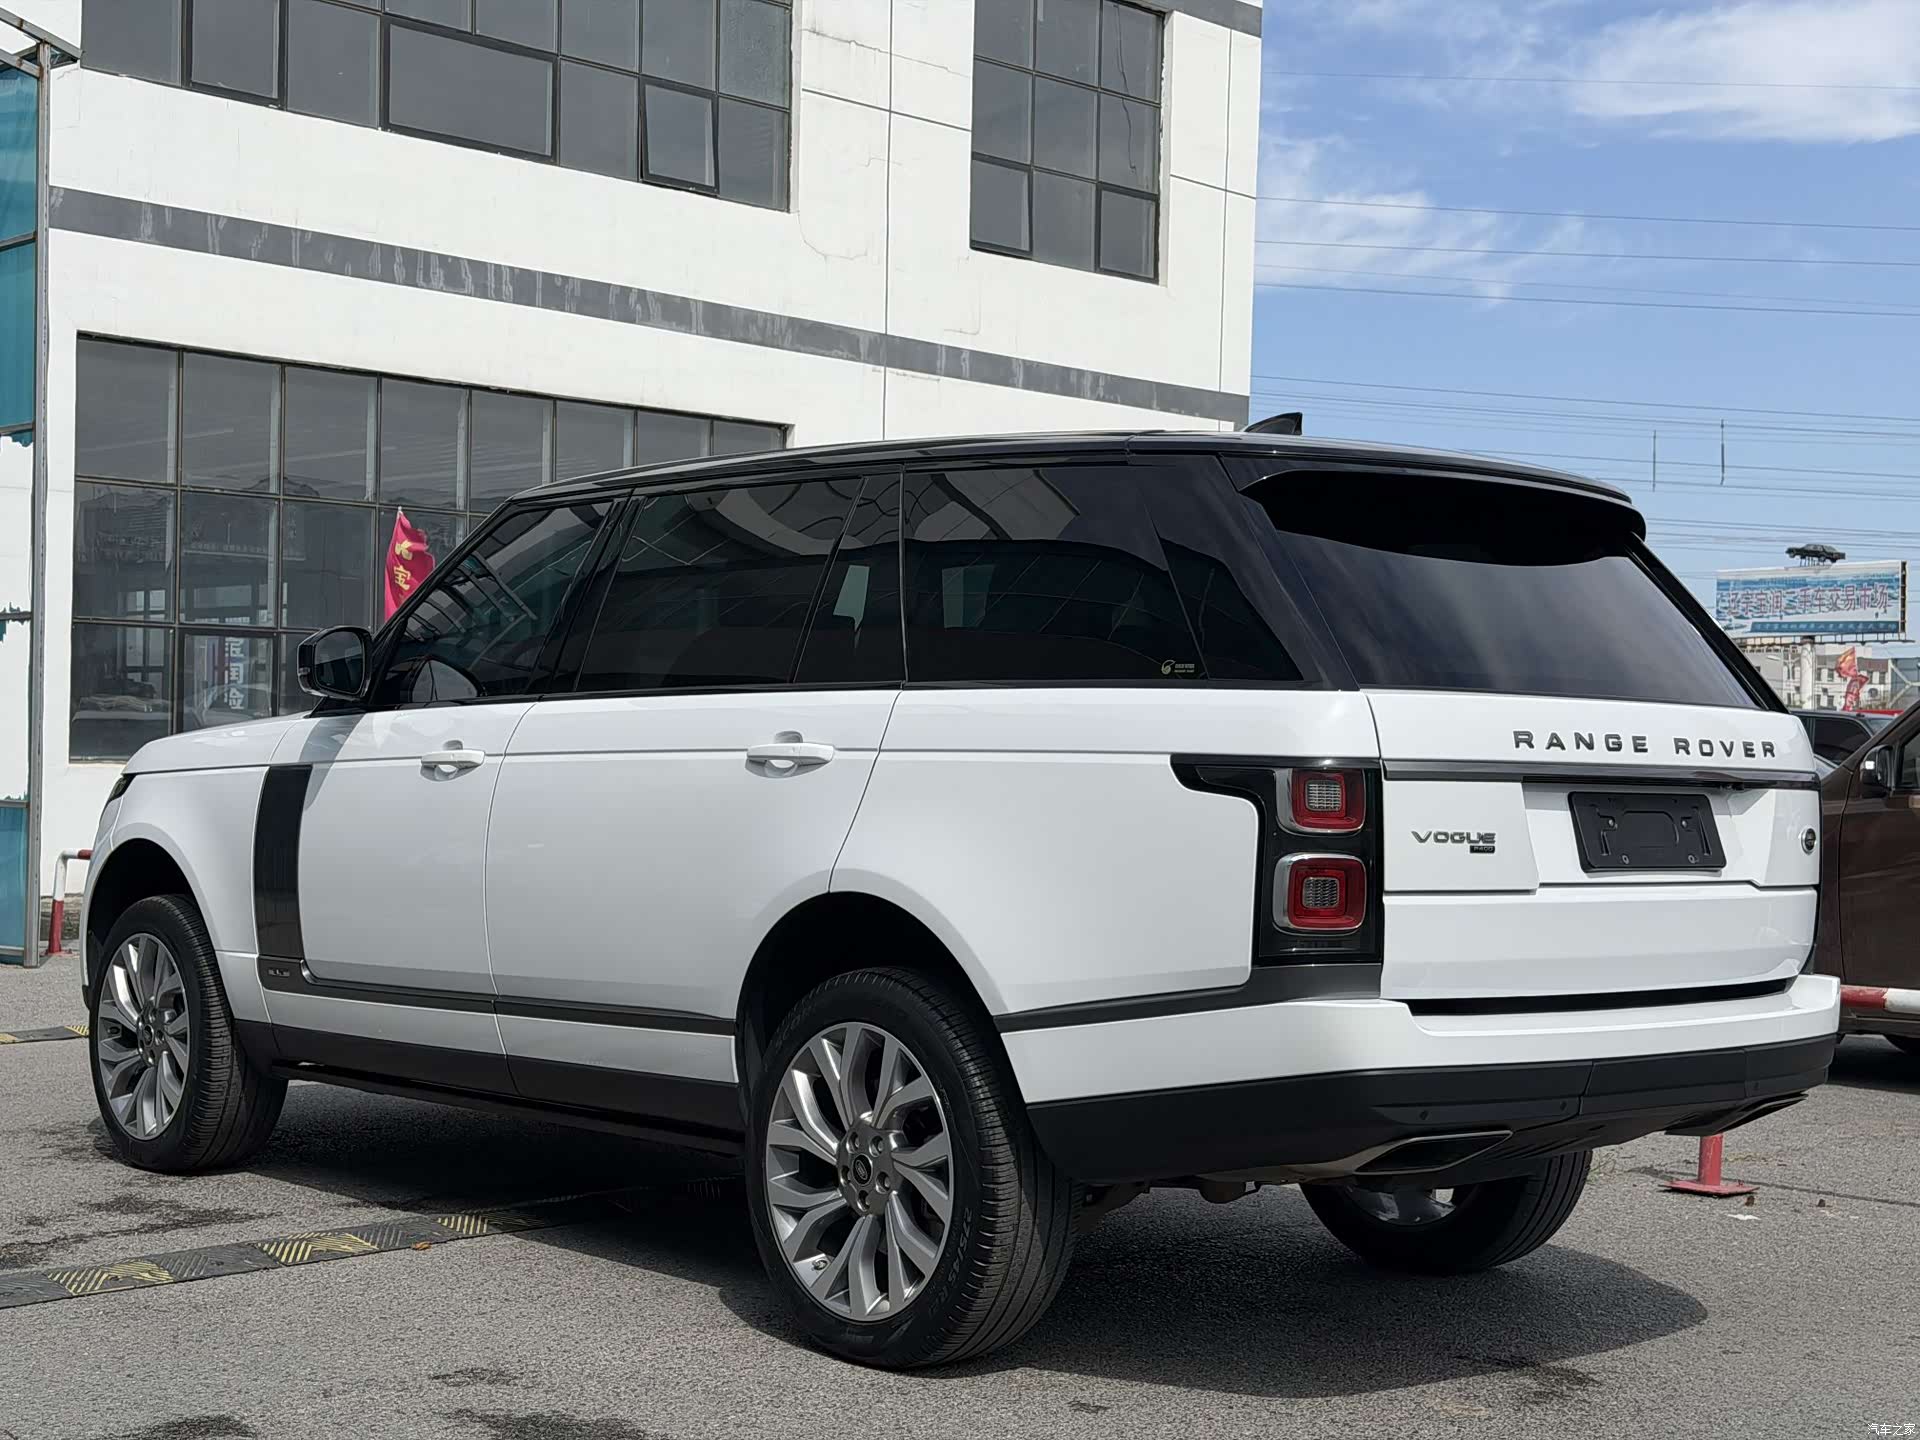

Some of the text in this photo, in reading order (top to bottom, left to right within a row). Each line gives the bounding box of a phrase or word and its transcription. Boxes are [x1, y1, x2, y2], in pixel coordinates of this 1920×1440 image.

[1512, 730, 1776, 759] RANGE ROVER
[1411, 830, 1496, 844] VOGUE
